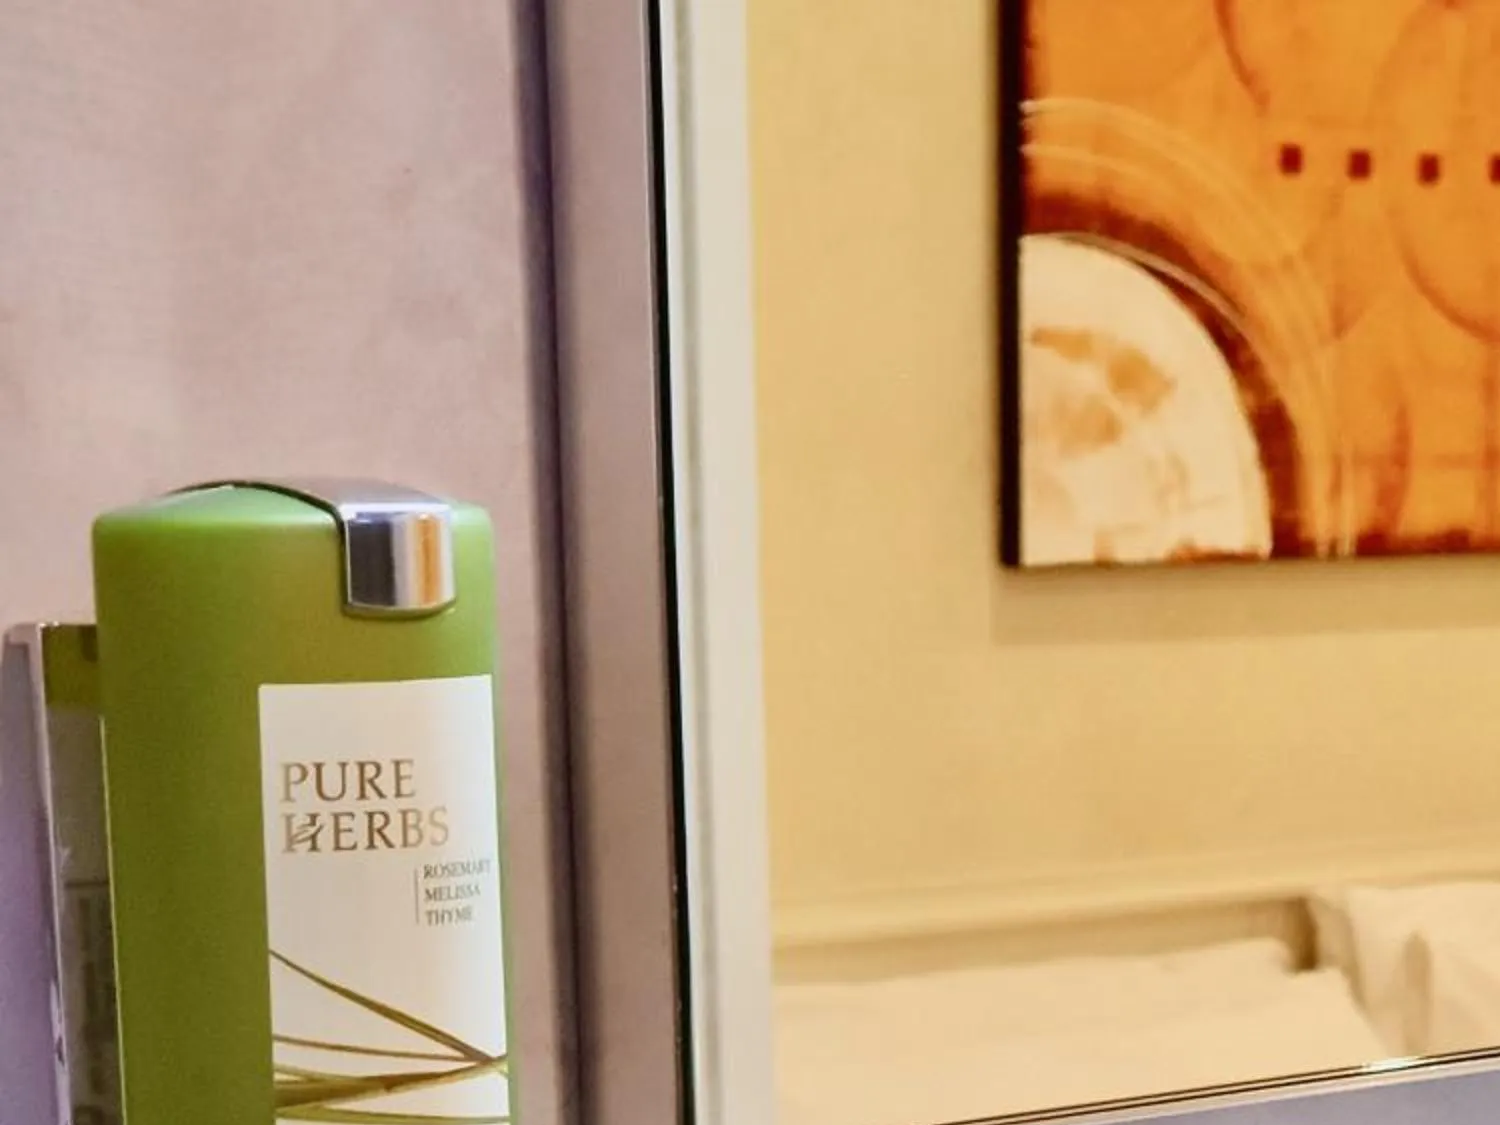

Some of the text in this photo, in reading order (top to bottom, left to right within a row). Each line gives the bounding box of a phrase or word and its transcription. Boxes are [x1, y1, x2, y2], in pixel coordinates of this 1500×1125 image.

[281, 759, 416, 802] PURE
[282, 806, 450, 853] HERBS
[424, 882, 482, 903] MELISSA
[425, 907, 474, 927] THYME
